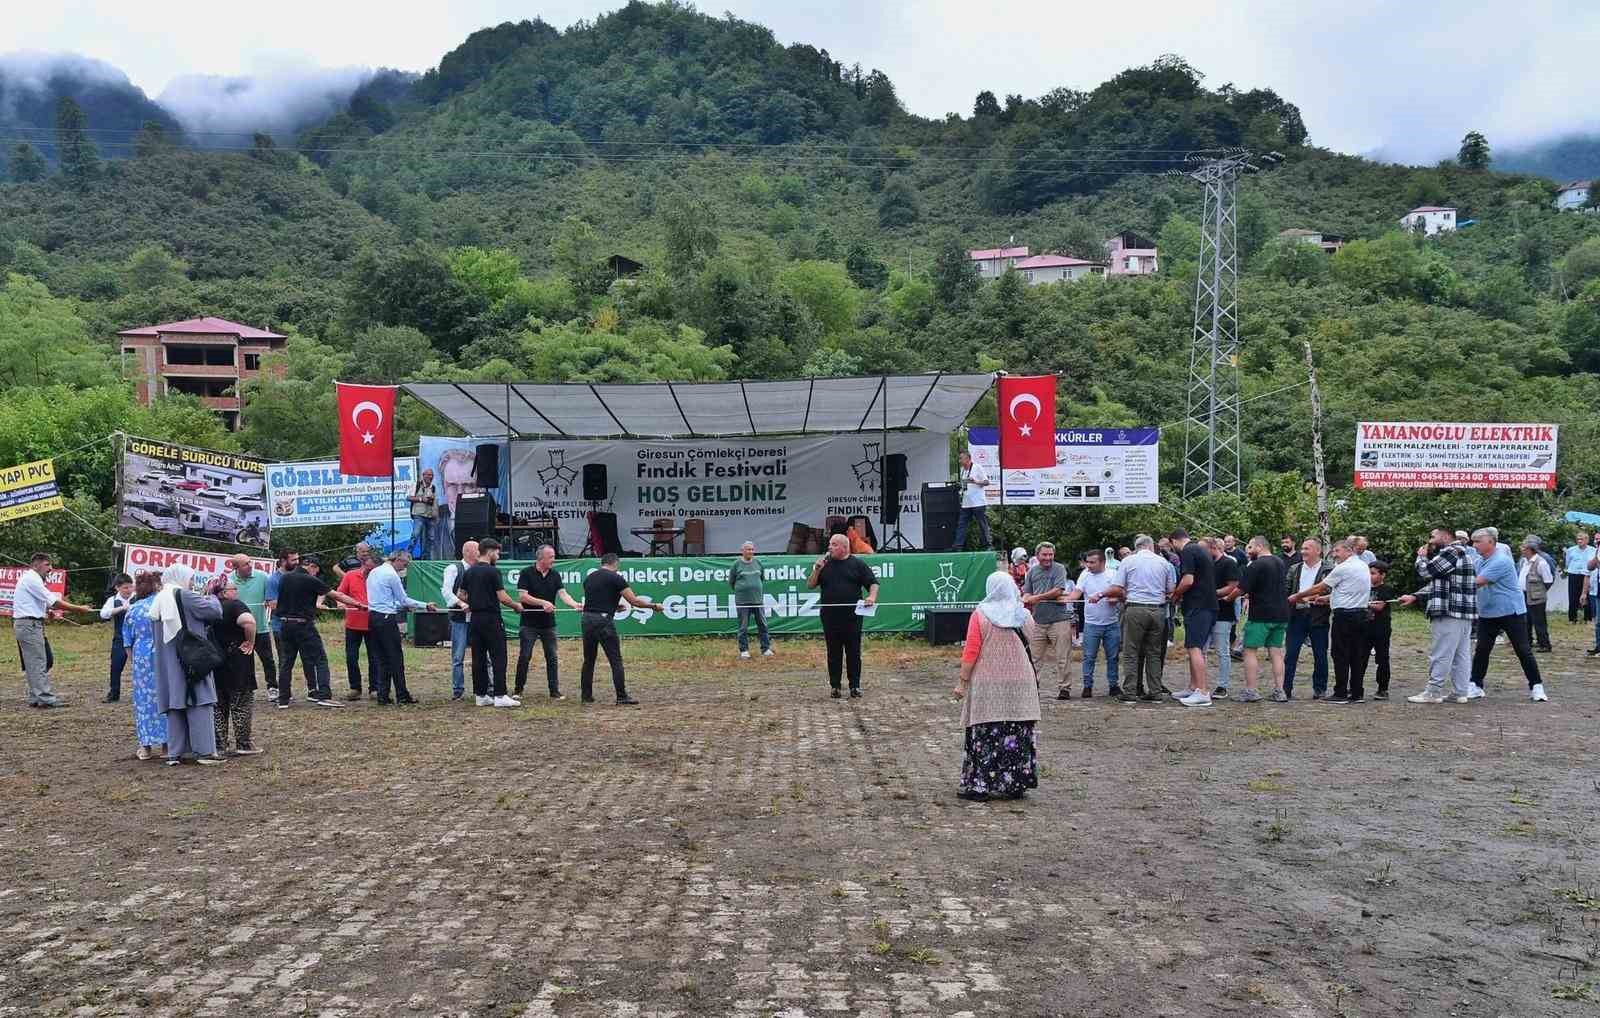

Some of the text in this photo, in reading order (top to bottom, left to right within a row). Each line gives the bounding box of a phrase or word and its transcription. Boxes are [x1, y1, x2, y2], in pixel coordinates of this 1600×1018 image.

[1054, 431, 1103, 443] KKÜRLER
[1362, 424, 1466, 441] YAMANOĞLU
[637, 446, 787, 462] Giresun Çömlekçi Deresi
[0, 463, 51, 485] YAPI PVC
[234, 459, 265, 474] KURS
[637, 459, 787, 478] Fındık Festivali
[637, 480, 787, 507] HOŞ GELDİNİZ
[552, 509, 588, 519] FESTİV
[638, 505, 785, 518] Festival Organizasyon Komitesi
[827, 505, 863, 515] FINDIK
[662, 586, 821, 619] GELNİZ
